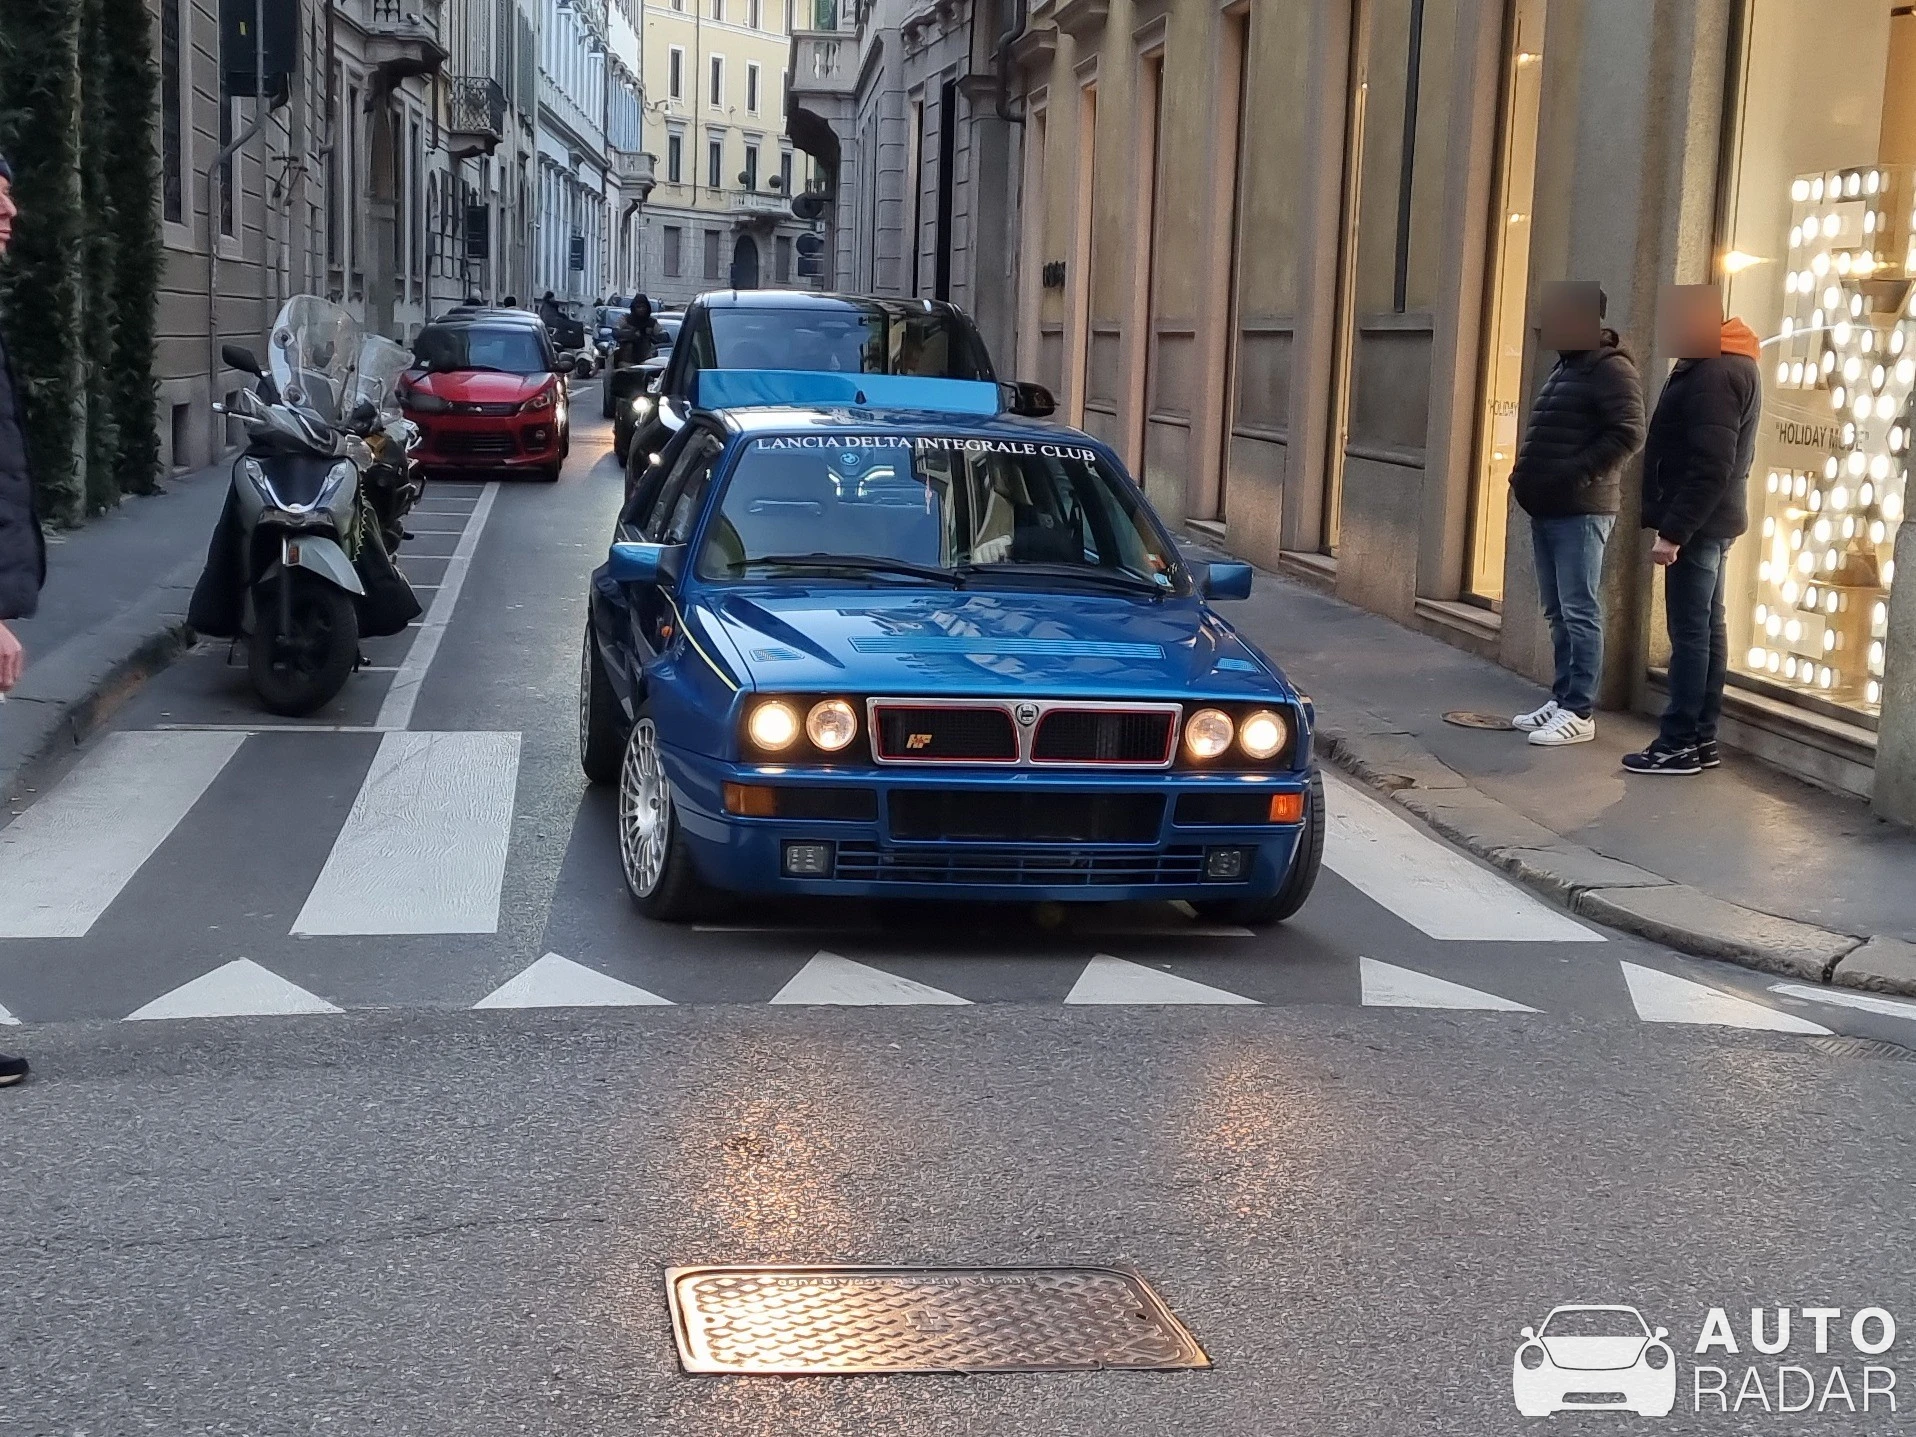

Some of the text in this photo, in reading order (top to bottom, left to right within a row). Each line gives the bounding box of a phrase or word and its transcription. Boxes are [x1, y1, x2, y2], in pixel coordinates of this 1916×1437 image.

[757, 436, 1096, 462] LANCIA DELTA INTEGRALE CLUB
[906, 734, 932, 749] HF
